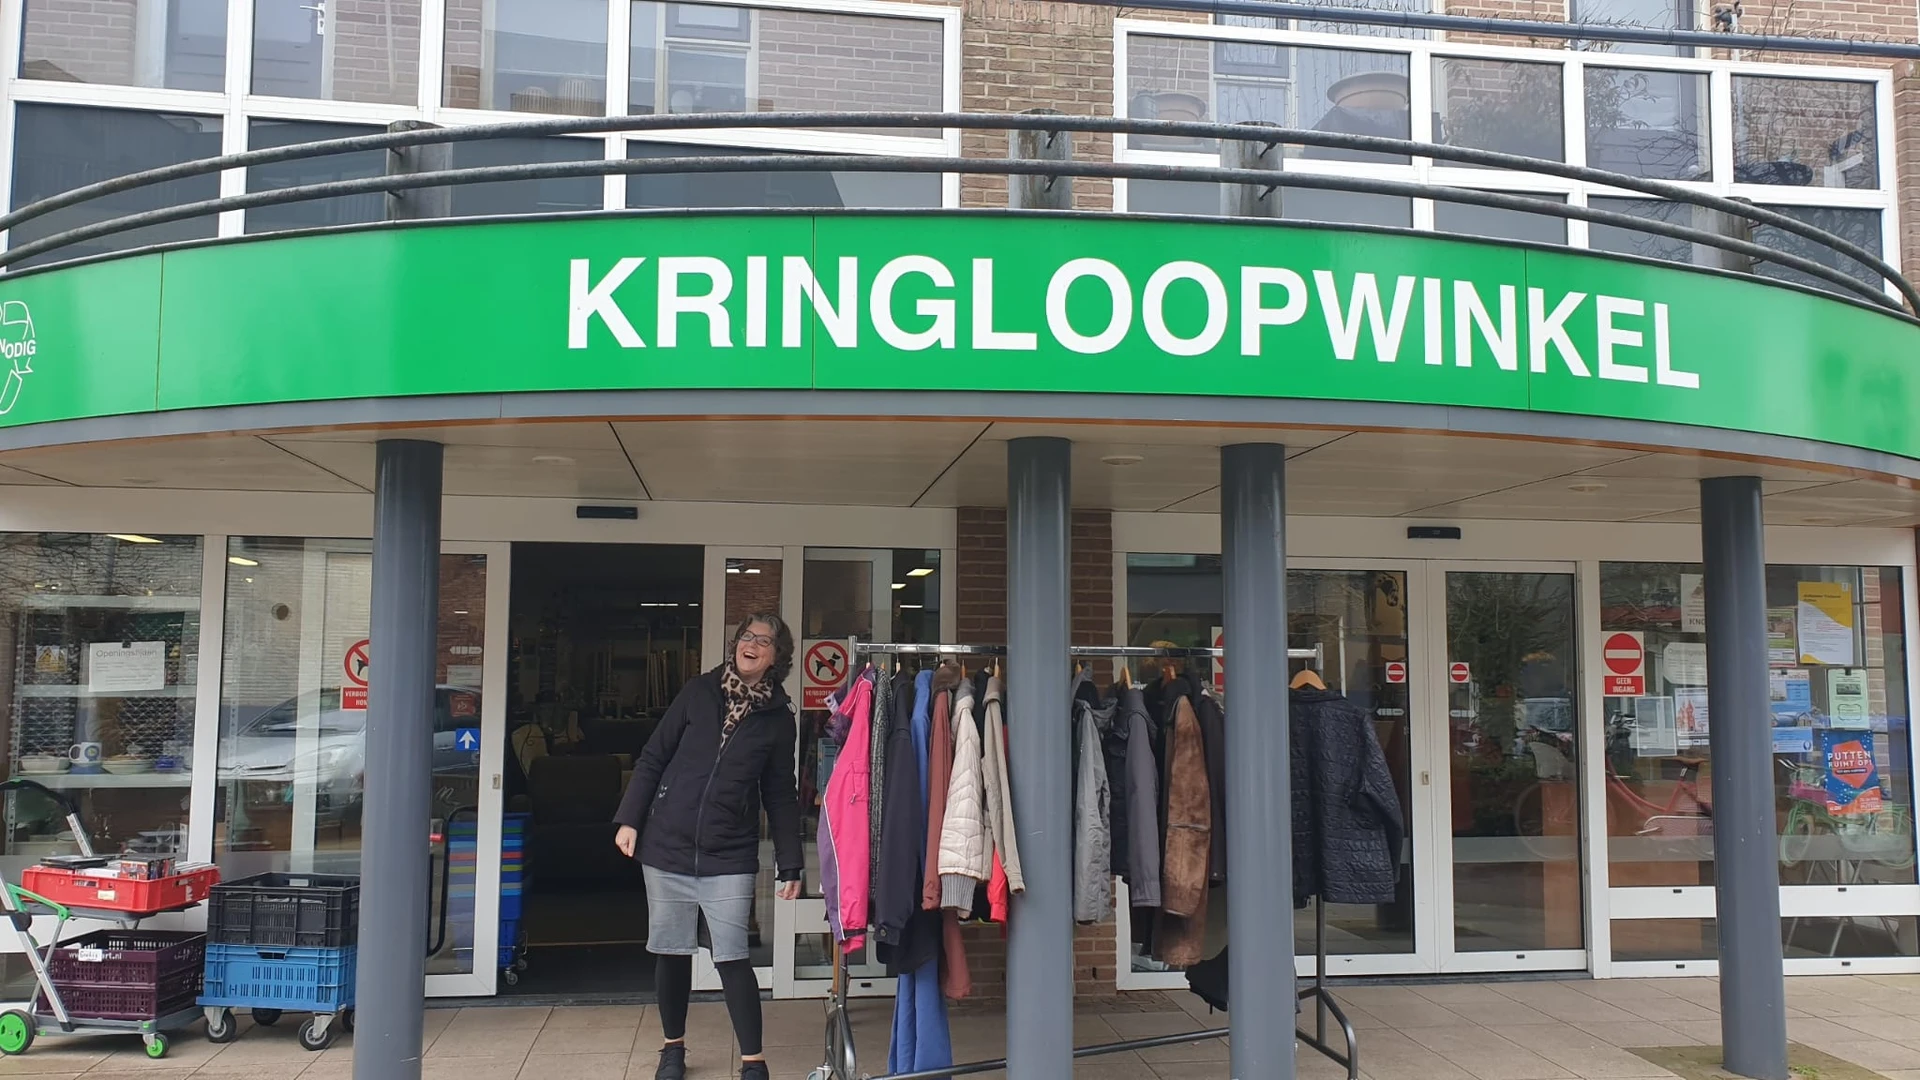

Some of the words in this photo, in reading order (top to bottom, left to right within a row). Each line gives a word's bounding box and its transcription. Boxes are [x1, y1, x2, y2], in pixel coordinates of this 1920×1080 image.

[568, 255, 1700, 389] KRINGLOOPWINKEL
[1616, 677, 1632, 685] GEEN
[1612, 685, 1636, 693] INGANG
[1827, 750, 1872, 761] PUTTEN
